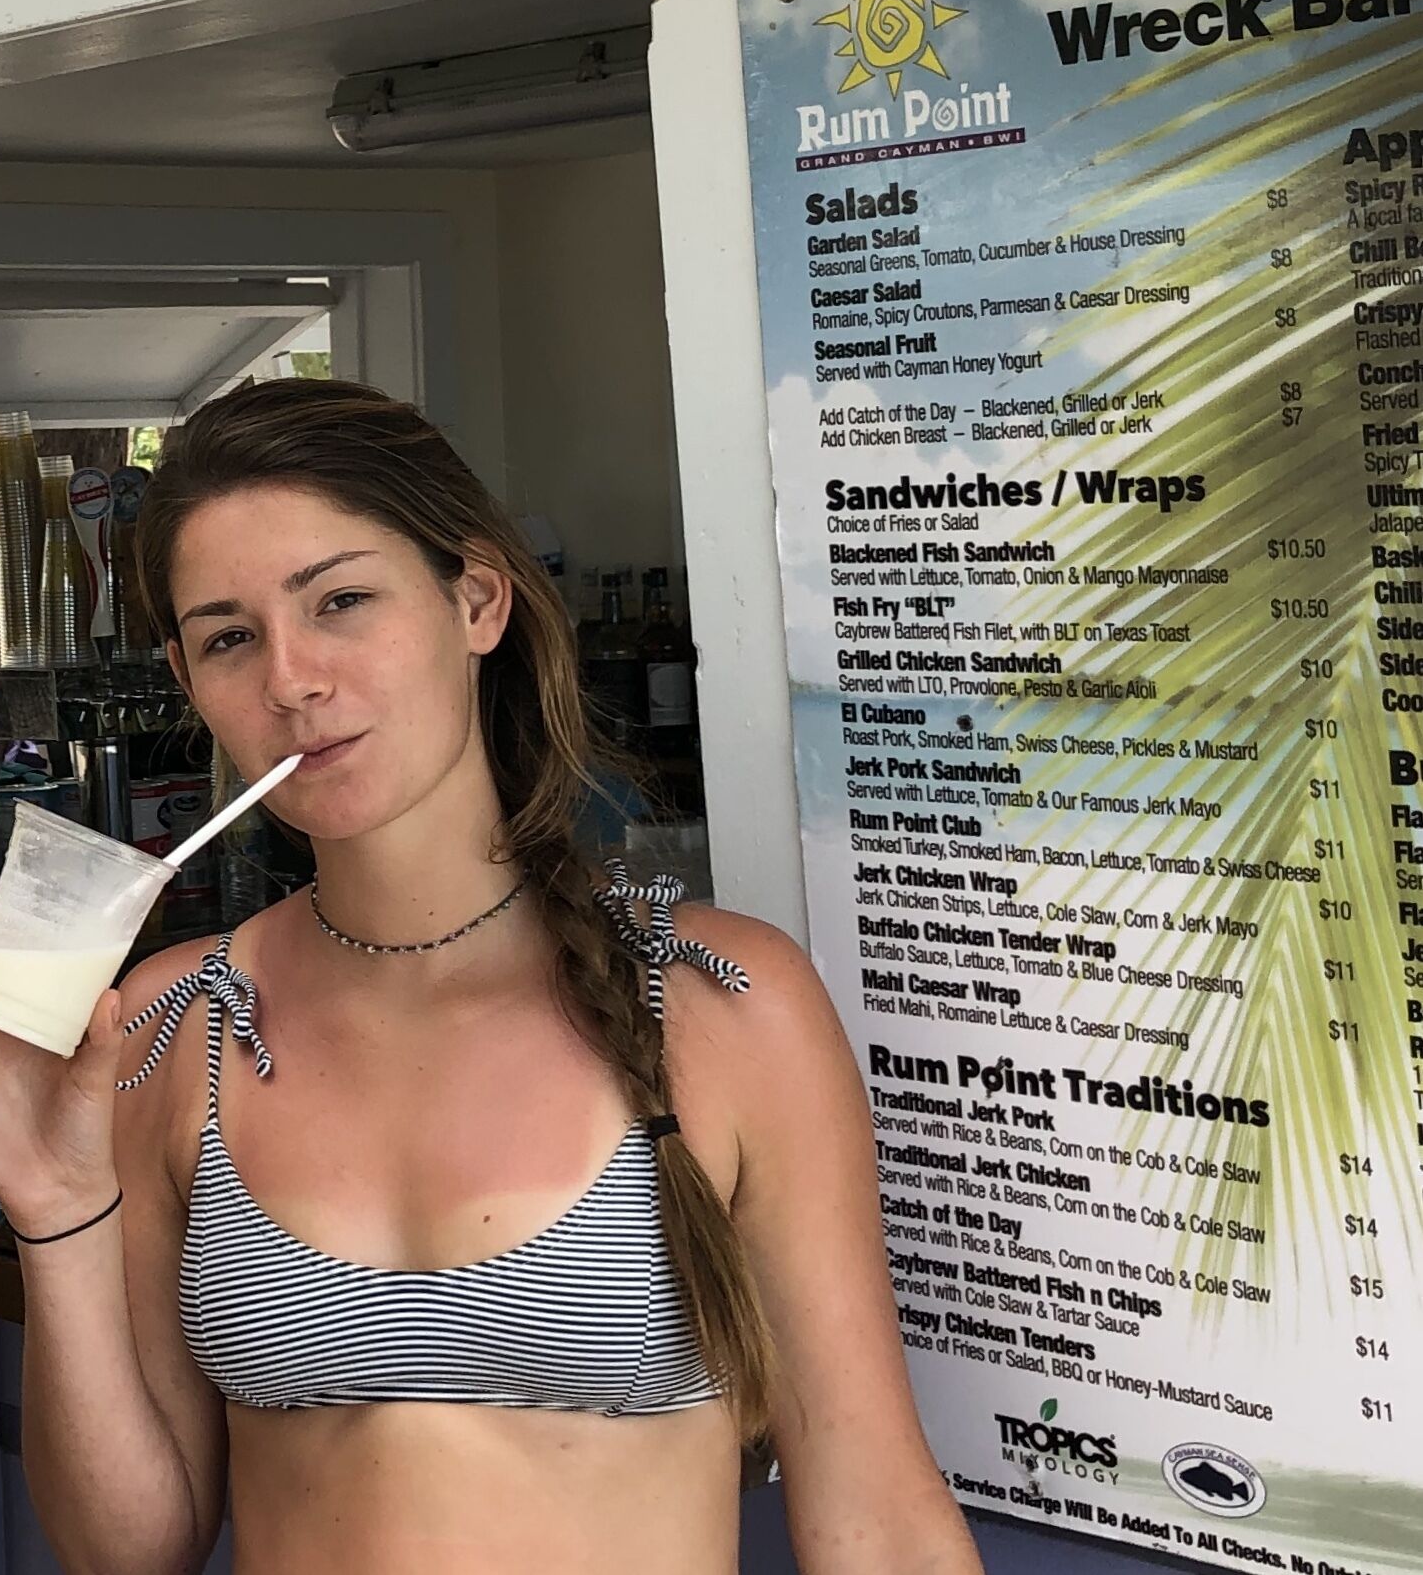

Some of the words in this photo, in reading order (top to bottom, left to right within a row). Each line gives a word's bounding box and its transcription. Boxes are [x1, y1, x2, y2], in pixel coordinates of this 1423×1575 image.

[795, 104, 890, 152] Rum
[904, 82, 1011, 138] Point
[800, 151, 865, 170] GRAND
[878, 139, 960, 159] CAYMAN
[805, 182, 918, 225] Salads
[1266, 189, 1288, 210] $8
[1344, 178, 1406, 208] Spicy
[806, 232, 868, 255] Garden
[871, 225, 921, 250] Salad
[807, 252, 867, 277] Seasonal
[868, 253, 920, 272] Greens,
[923, 245, 976, 266] Tomato,
[977, 238, 1051, 261] Cucumber
[1053, 234, 1067, 255] &
[1069, 233, 1118, 252] House
[1119, 224, 1186, 248] Dressing
[1270, 248, 1293, 270] $8
[809, 287, 870, 307] Caesar
[872, 278, 922, 302] Salad
[811, 306, 872, 328] Romaine,
[873, 305, 911, 329] Spicy
[912, 301, 977, 322] Croutons,
[979, 296, 1051, 316] Parmesan
[1053, 291, 1066, 311] &
[1068, 290, 1119, 309] Caesar
[1123, 282, 1190, 304] Dressing
[1275, 307, 1297, 328] $8
[813, 336, 892, 359] Seasonal
[894, 333, 938, 355] Fruit
[1356, 328, 1420, 351] Flashed
[815, 362, 861, 382] Served
[862, 359, 892, 379] with
[893, 358, 950, 380] Cayman
[951, 355, 996, 375] Honey
[998, 349, 1043, 373] Yogurt
[1280, 382, 1302, 403] $8
[1360, 389, 1419, 411] Served
[1282, 407, 1303, 427] $7
[1362, 422, 1419, 446] Fried
[1364, 450, 1409, 475] Spicy
[825, 472, 1044, 512] Sandwiches
[1075, 470, 1206, 514] Wraps
[826, 514, 871, 532] Choice
[872, 513, 887, 531] of
[888, 513, 922, 531] Fries
[923, 517, 939, 531] or
[940, 511, 980, 530] Salad
[828, 543, 919, 563] Blackened
[921, 542, 960, 562] Fish
[963, 541, 1056, 561] Sandwich
[1267, 538, 1325, 560] $10.50
[832, 597, 869, 616] Fish
[871, 596, 901, 620] Fry
[1270, 598, 1329, 620] $10.50
[836, 650, 893, 671] Grilled
[895, 651, 967, 671] Chicken
[969, 652, 1063, 673] Sandwich
[1300, 658, 1333, 679] $10
[840, 702, 858, 723] El
[860, 703, 927, 725] Cubano
[1305, 718, 1338, 740] $10
[844, 756, 885, 777] Jerk
[886, 757, 929, 779] Pork
[931, 760, 1022, 783] Sandwich
[1309, 778, 1341, 800] $11
[848, 808, 890, 830] Rum
[891, 808, 939, 833] Point
[940, 811, 983, 836] Club
[1314, 838, 1345, 861] $11
[852, 862, 893, 884] Jerk
[894, 865, 967, 890] Chicken
[969, 870, 1019, 898] Wrap
[1319, 898, 1352, 922] $10
[857, 915, 920, 940] Buffalo
[922, 921, 996, 947] Chicken
[1000, 928, 1062, 953] Tender
[1065, 934, 1118, 962] Wrap
[1323, 959, 1355, 982] $11
[861, 969, 905, 993] Mahi
[907, 973, 969, 999] Caesar
[972, 980, 1022, 1009] Wrap
[1328, 1019, 1360, 1043] $11
[868, 1043, 950, 1086] Rum
[957, 1056, 1058, 1101] Point
[1063, 1068, 1271, 1129] Traditions
[870, 1086, 963, 1118] Traditional
[966, 1099, 1009, 1125] Jerk
[1010, 1105, 1056, 1131] Pork
[876, 1140, 967, 1173] Traditional
[970, 1154, 1013, 1180] Jerk
[1014, 1161, 1092, 1192] Chicken
[1339, 1152, 1374, 1177] $14
[879, 1194, 928, 1221] Catch
[931, 1203, 951, 1225] of
[952, 1205, 985, 1230] the
[987, 1211, 1022, 1241] Day
[1344, 1214, 1379, 1239] $14
[962, 1260, 1043, 1295] Battered
[1045, 1276, 1086, 1303] Fish
[1088, 1288, 1104, 1306] n
[1106, 1286, 1163, 1320] Chips
[1350, 1274, 1385, 1300] $15
[898, 1304, 941, 1333] rispy
[943, 1311, 1018, 1345] Chicken
[1022, 1326, 1097, 1361] Tenders
[1355, 1335, 1390, 1361] $14
[1361, 1396, 1394, 1423] $11
[994, 1413, 1118, 1468] TROPICS
[953, 1473, 1006, 1500] Service
[1065, 1498, 1093, 1521] Will
[1097, 1507, 1118, 1527] Be
[1121, 1514, 1170, 1541] Added
[1174, 1525, 1194, 1546] To
[1197, 1531, 1218, 1552] All
[1221, 1538, 1287, 1570] Checks.
